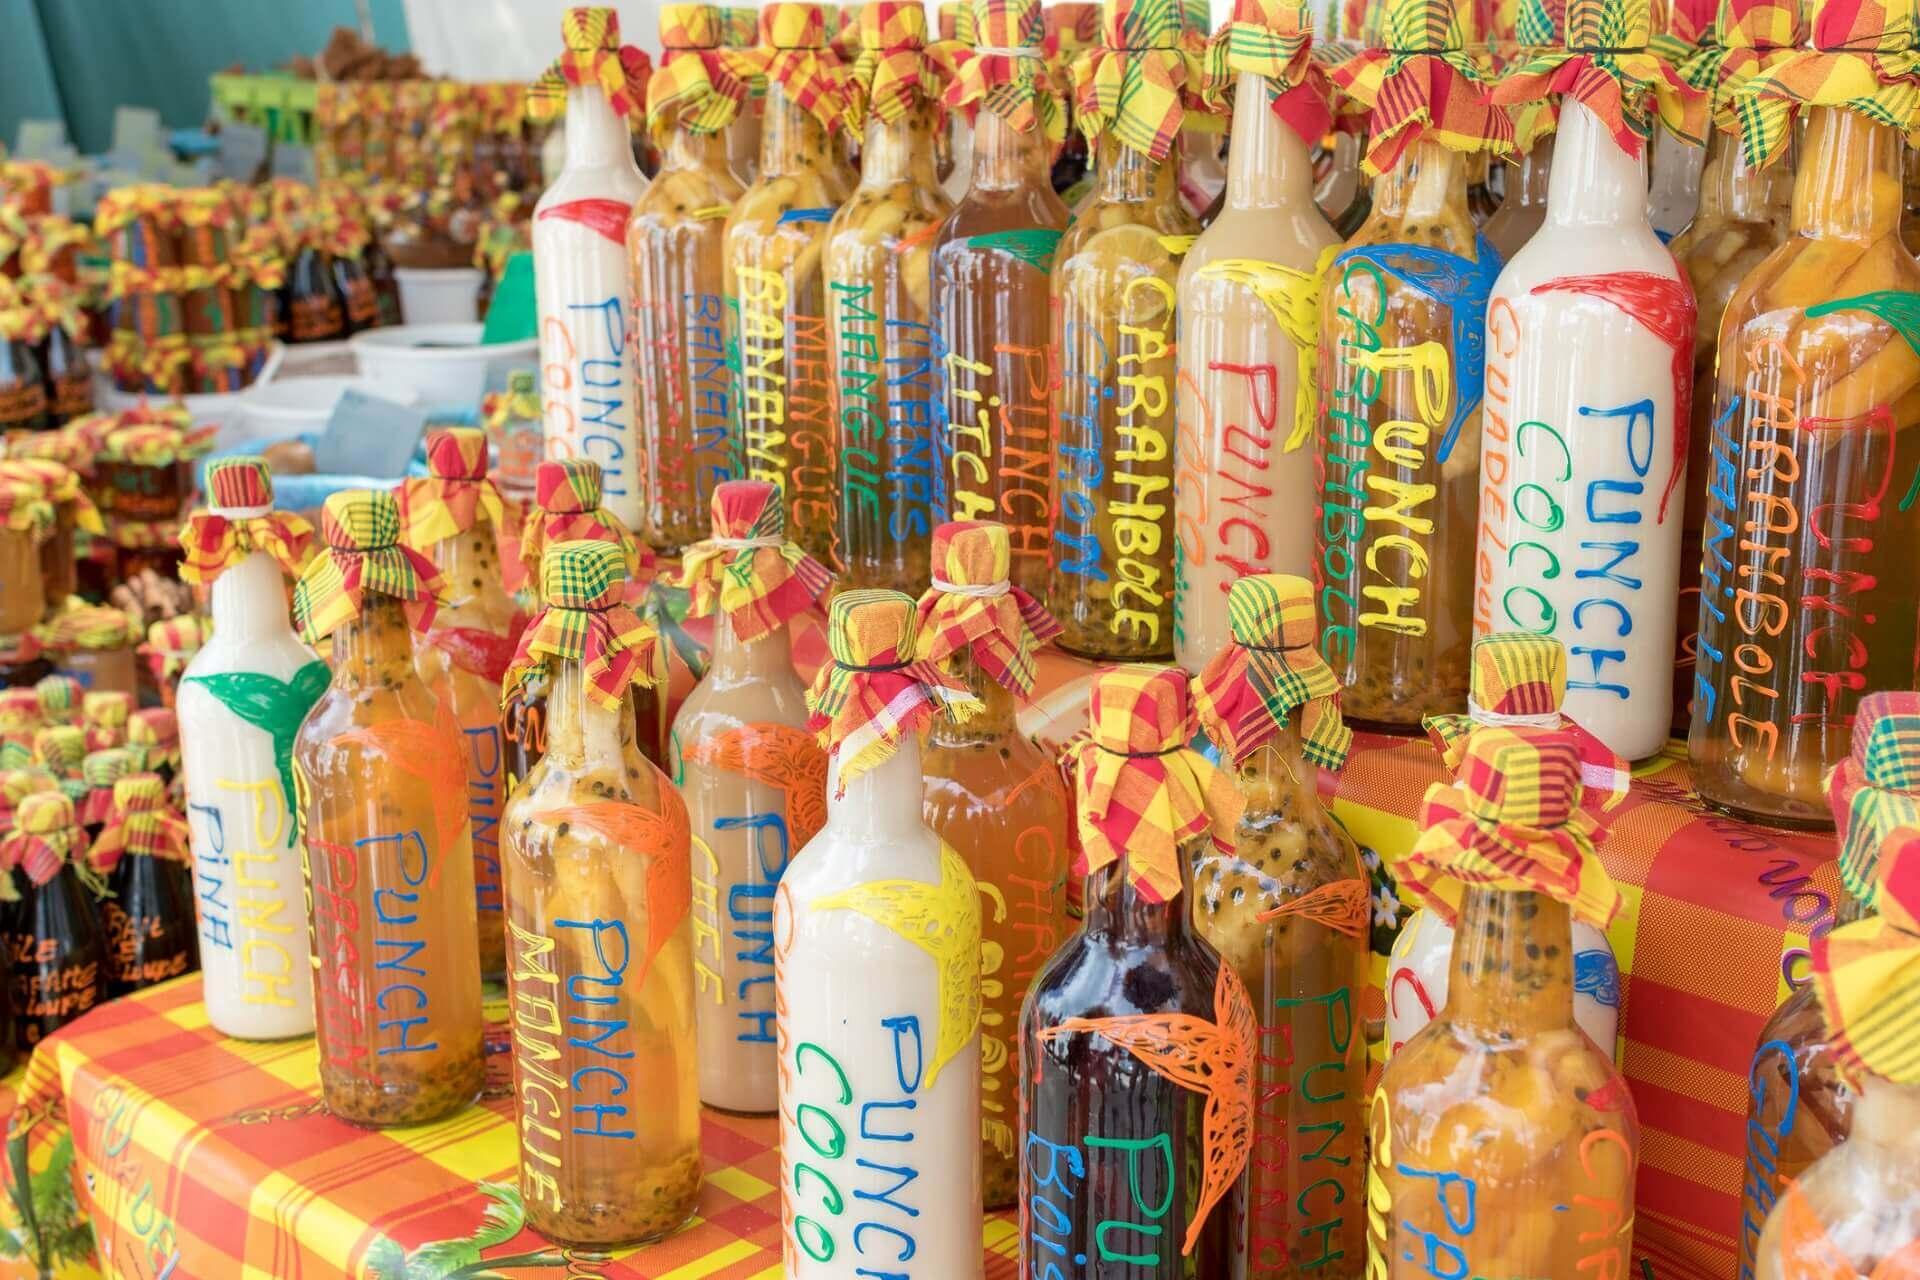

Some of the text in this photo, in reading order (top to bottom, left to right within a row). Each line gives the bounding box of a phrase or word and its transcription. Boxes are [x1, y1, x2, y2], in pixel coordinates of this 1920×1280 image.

[568, 296, 627, 497] PUNCH
[684, 293, 730, 498] BANANE
[736, 266, 787, 496] BANANE
[787, 314, 828, 528] MANGUE
[830, 282, 884, 520] MANGUE
[994, 343, 1052, 556] PUNCH
[1108, 277, 1177, 646] CARAMBOLE
[1177, 368, 1212, 567] COCO
[1209, 362, 1278, 595] PUNCH
[1321, 262, 1387, 664] CARAMBOLE
[1344, 342, 1449, 637] PUNCH
[1503, 421, 1572, 635] COCO
[1567, 398, 1655, 699] PUNCH
[1727, 338, 1807, 760] CARAMBOLE
[1791, 404, 1897, 728] PUNCH
[219, 777, 296, 1008] PUNCH
[355, 830, 440, 1056] PUNCH
[508, 918, 570, 1214] MANGUE
[554, 918, 636, 1140] PUNCH
[1275, 987, 1352, 1269] PUNCH
[794, 1042, 853, 1262] COCO
